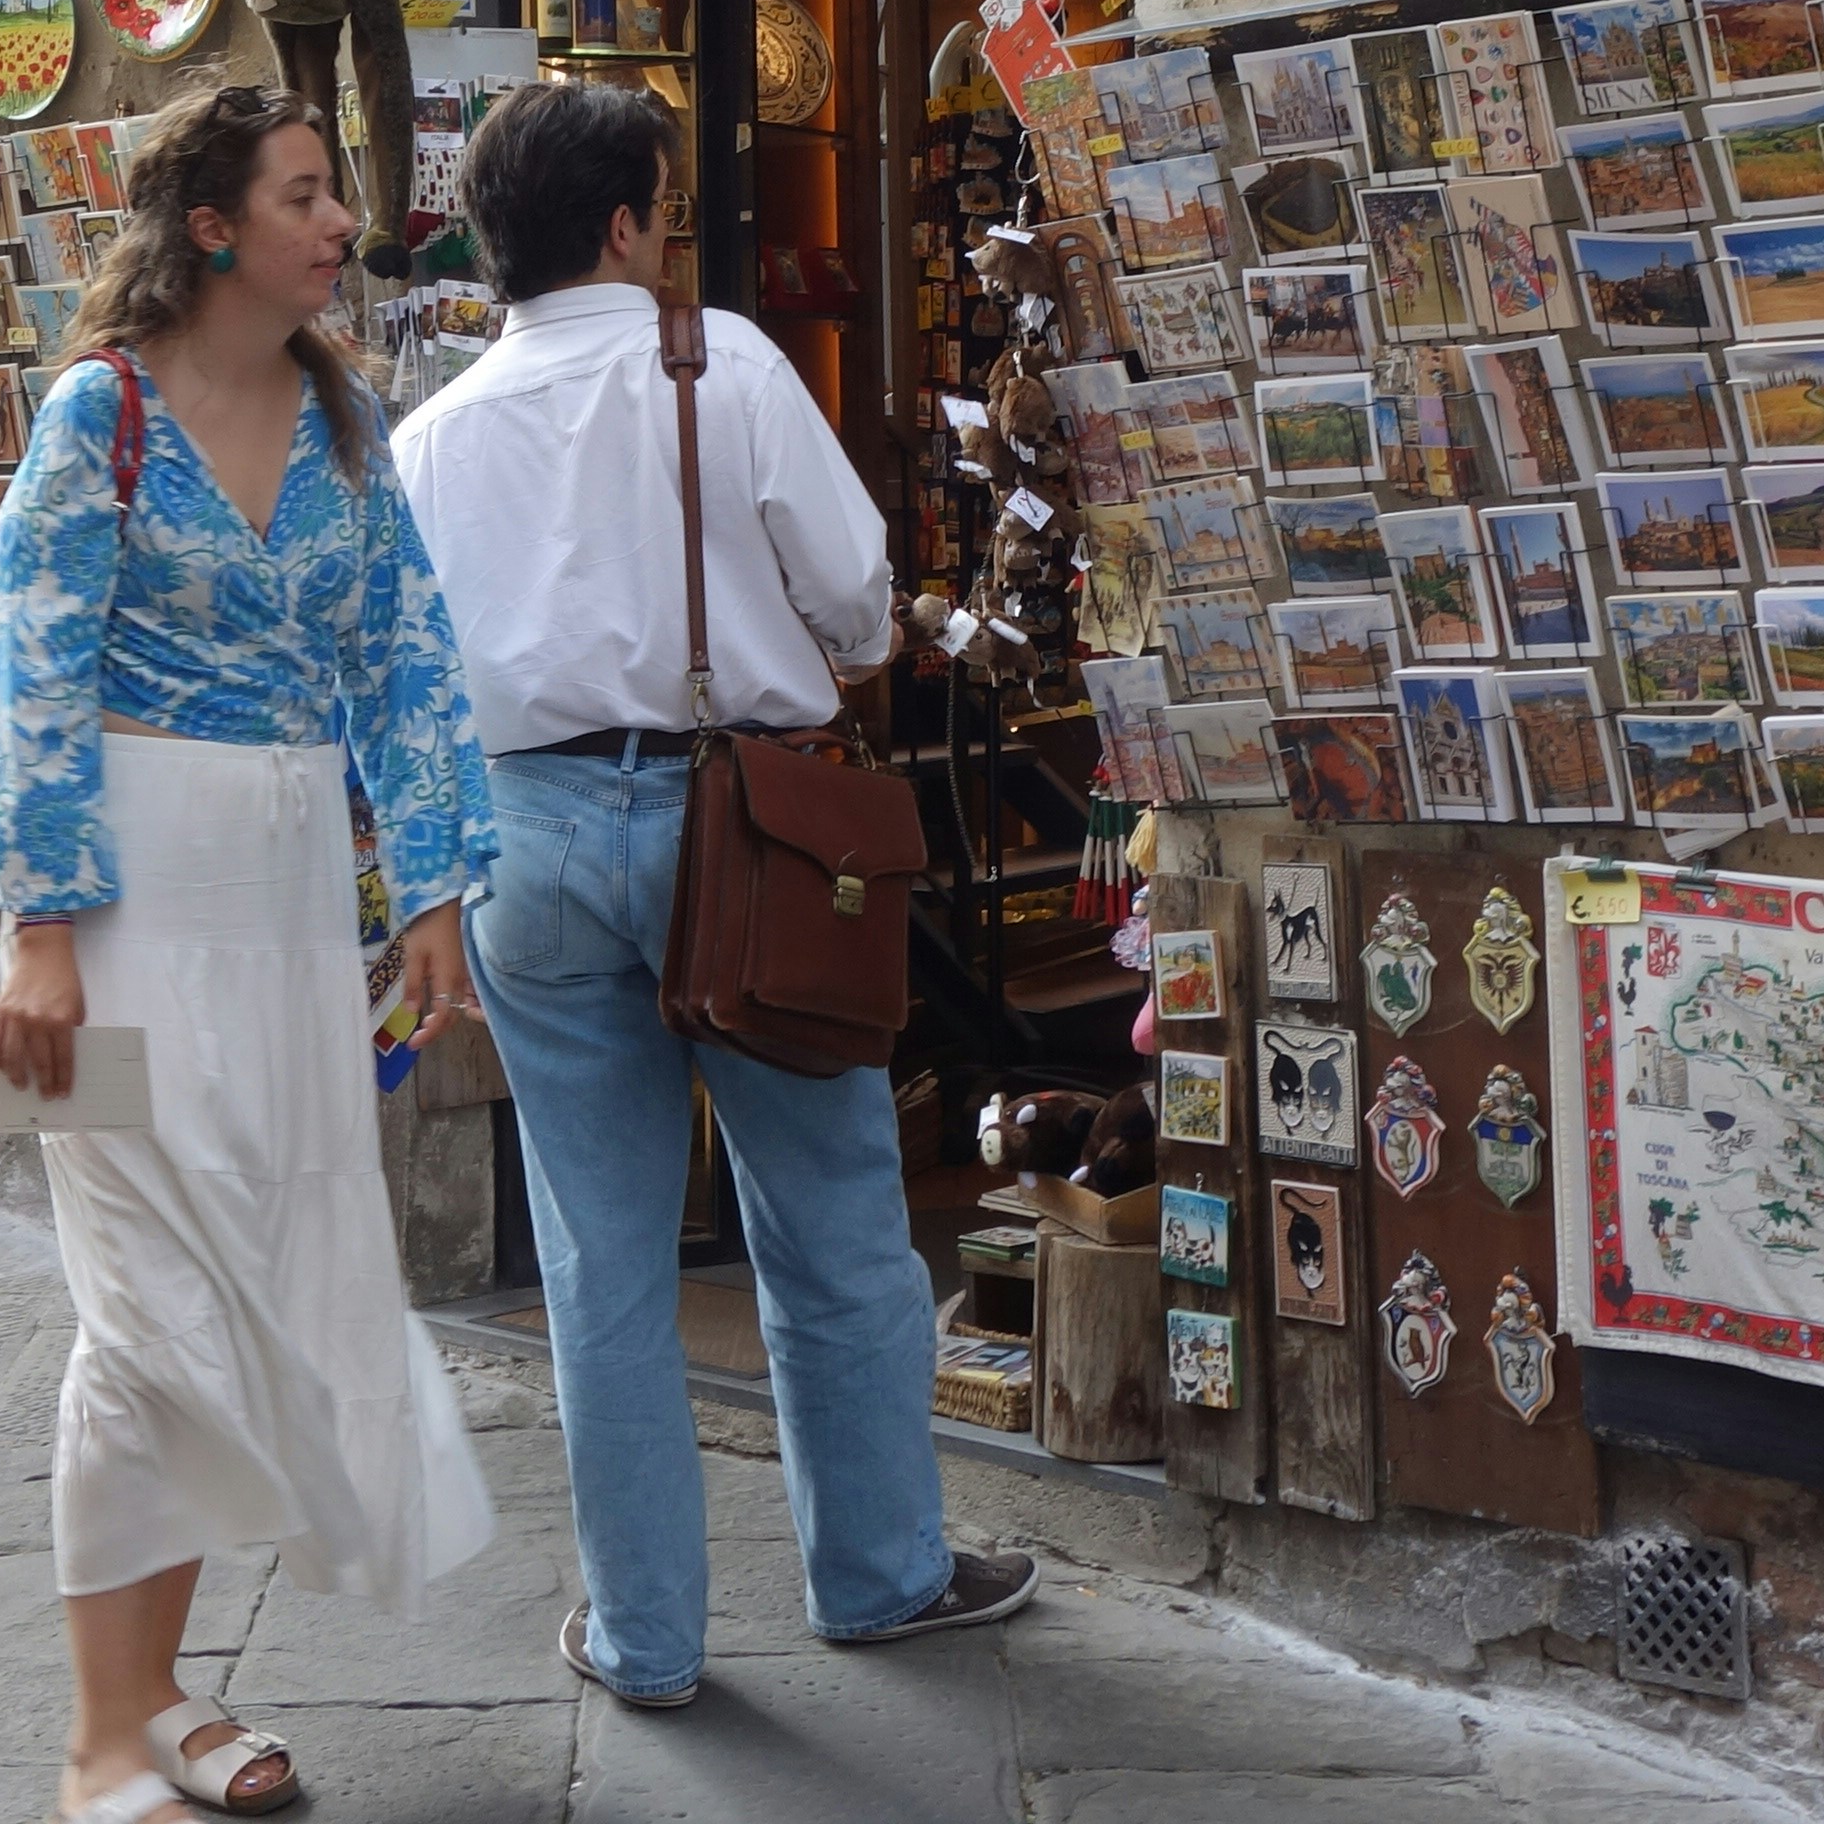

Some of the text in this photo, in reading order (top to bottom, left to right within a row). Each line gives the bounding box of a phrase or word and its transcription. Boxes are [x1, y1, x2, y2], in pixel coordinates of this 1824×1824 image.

[1584, 83, 1656, 110] SIENA
[1805, 949, 1824, 965] Va
[1263, 1138, 1311, 1156] ATTENTI
[1319, 1145, 1354, 1165] GATTI
[1644, 1142, 1675, 1156] CUOR
[1655, 1159, 1669, 1171] DI
[1637, 1172, 1690, 1191] TOSCANA
